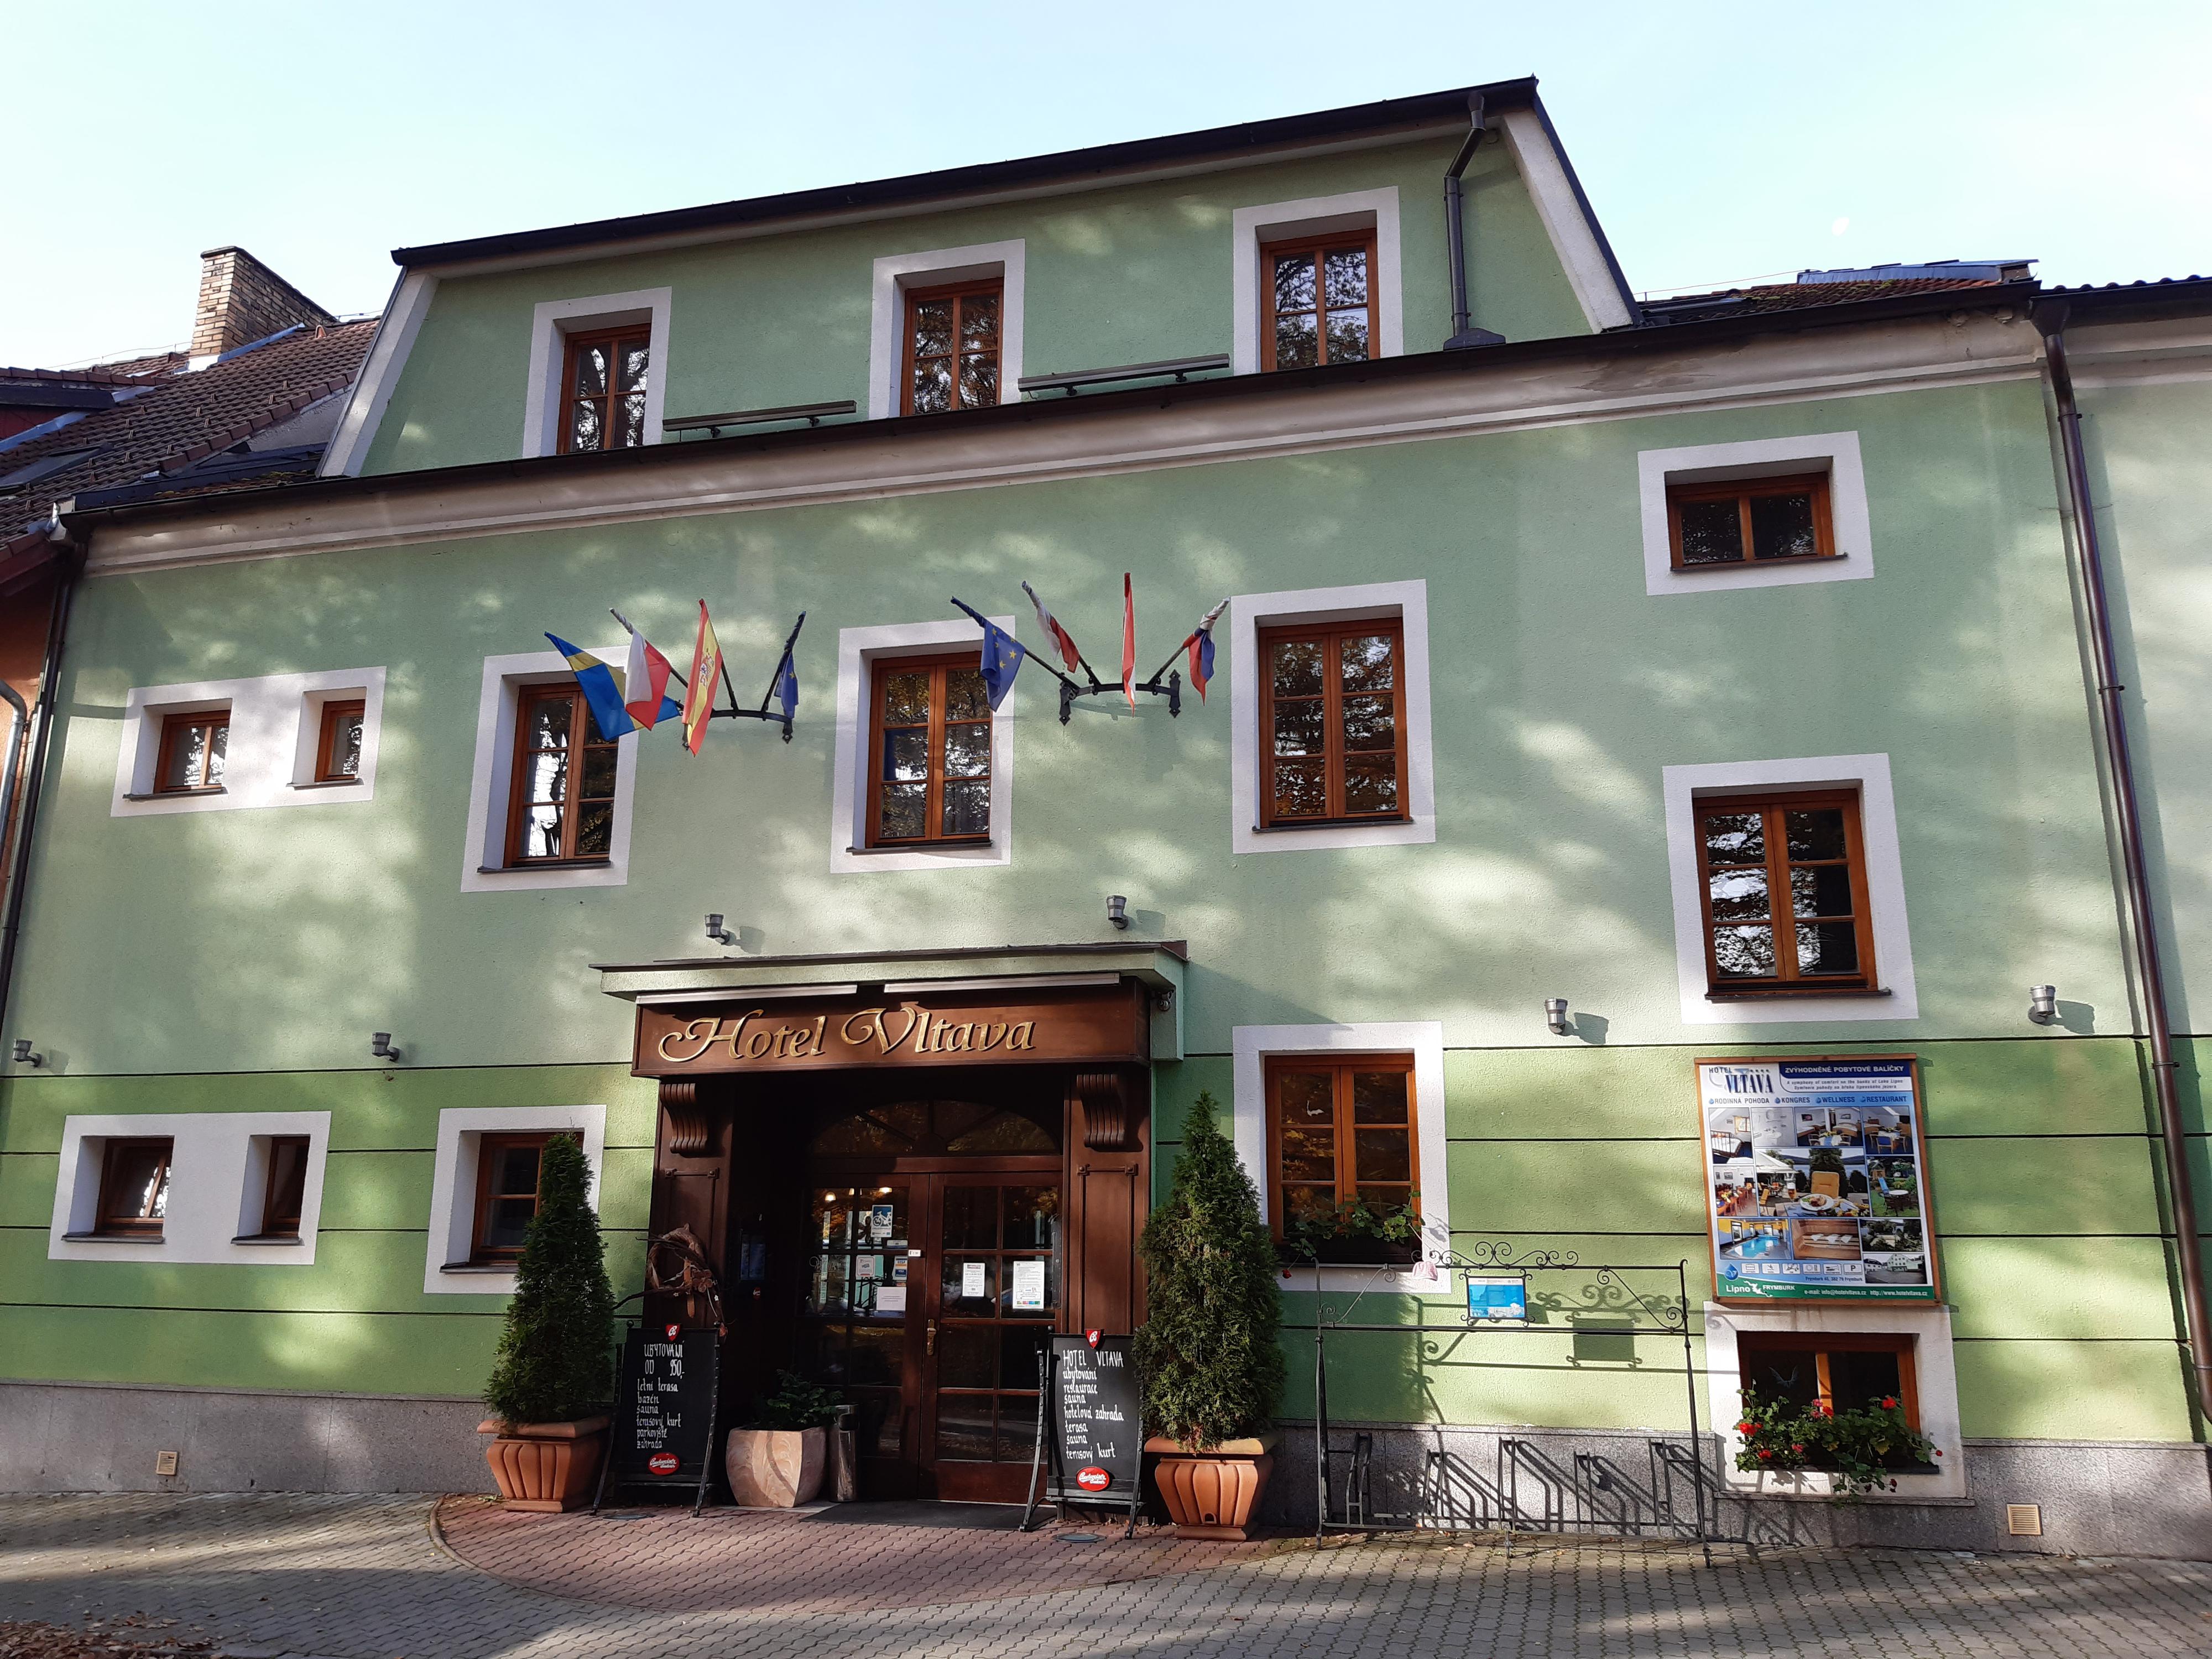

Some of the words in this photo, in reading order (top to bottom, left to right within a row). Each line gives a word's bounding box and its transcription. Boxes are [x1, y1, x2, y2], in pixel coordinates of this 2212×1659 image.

[658, 1009, 828, 1063] Hotel
[841, 1006, 1037, 1055] Vltava
[1725, 1074, 1773, 1093] VLTAVA
[1726, 1285, 1750, 1293] Lipno
[644, 1340, 685, 1358] UBYTOVÁNÍ
[1063, 1349, 1087, 1367] HOTEL
[1095, 1350, 1124, 1368] VLTAVA
[645, 1359, 654, 1375] OD
[670, 1359, 685, 1379] 950,-
[638, 1378, 654, 1391] letní
[658, 1376, 679, 1392] terasa
[1063, 1384, 1098, 1394] restaurace
[638, 1391, 660, 1404] bazén
[1065, 1394, 1086, 1404] sauna
[637, 1405, 659, 1414] sauna
[1064, 1405, 1092, 1419] hotelová
[1095, 1404, 1124, 1421] zahrada
[667, 1412, 681, 1427] kurt
[1065, 1420, 1088, 1433] terasa
[637, 1438, 662, 1449] zahrada
[1067, 1434, 1088, 1445] sauna
[1066, 1446, 1093, 1464] tenisový
[1097, 1442, 1116, 1458] kurt
